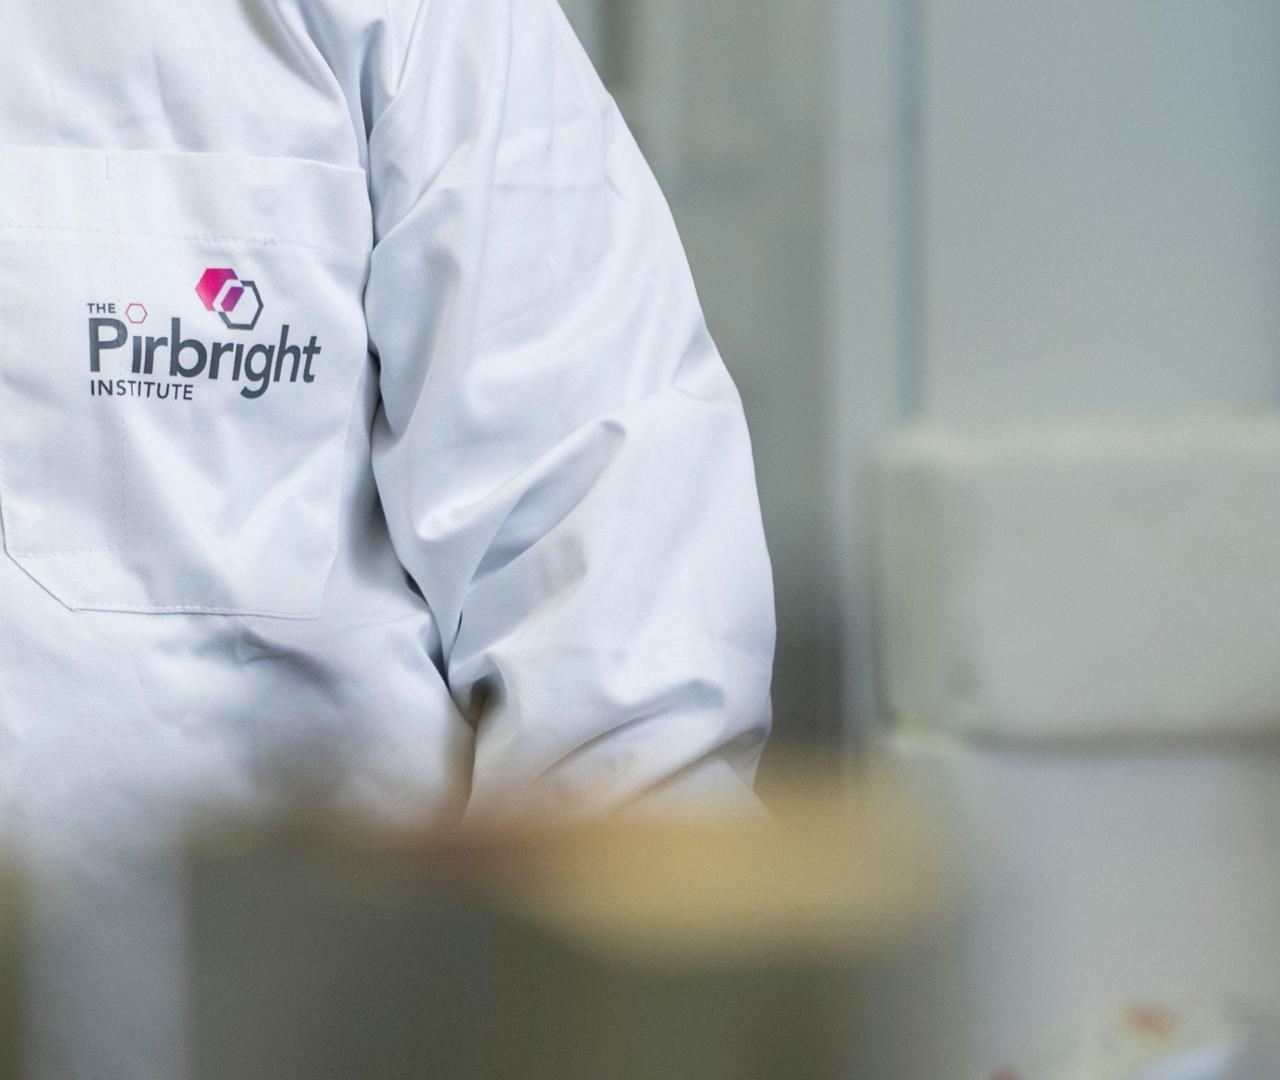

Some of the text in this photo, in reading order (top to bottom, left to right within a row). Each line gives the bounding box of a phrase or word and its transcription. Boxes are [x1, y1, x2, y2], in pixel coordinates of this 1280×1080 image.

[87, 302, 116, 314] THE
[88, 316, 322, 399] Pirbright
[90, 379, 194, 401] INSTITUTE
